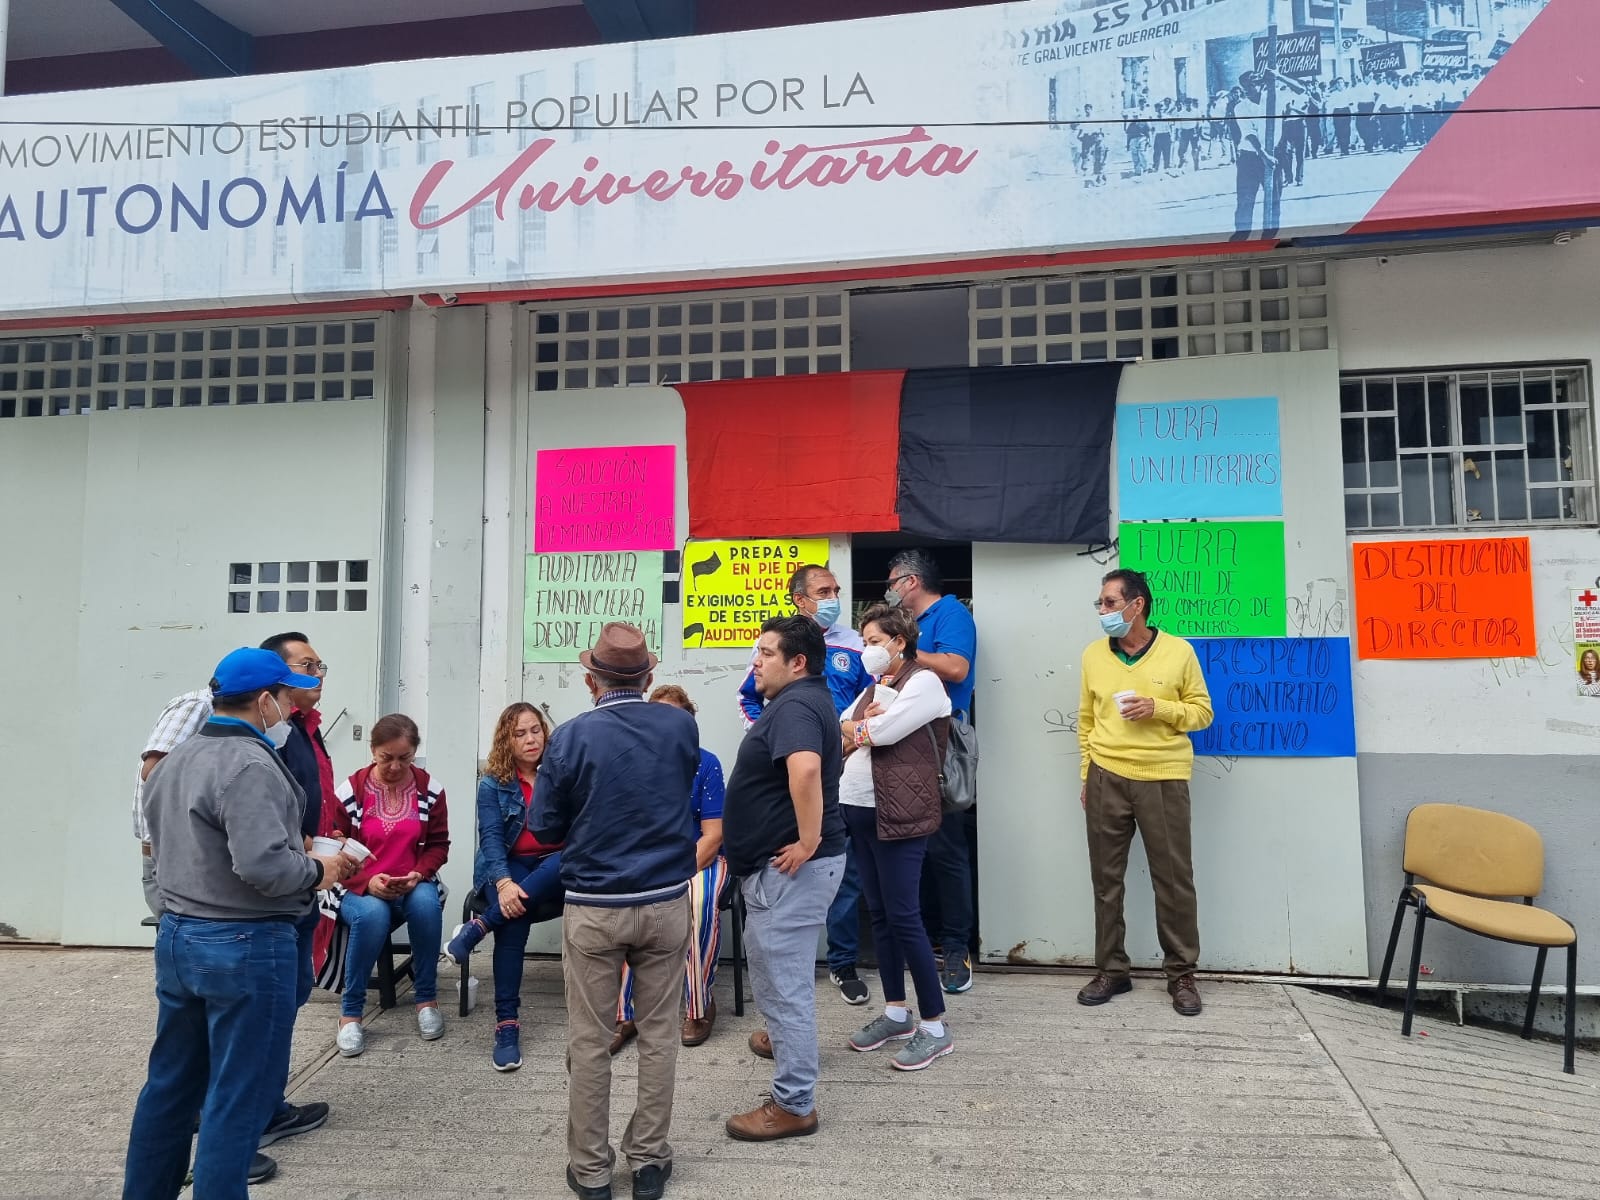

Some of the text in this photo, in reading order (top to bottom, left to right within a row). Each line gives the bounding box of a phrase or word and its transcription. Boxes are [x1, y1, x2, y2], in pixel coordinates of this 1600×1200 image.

[1092, 2, 1131, 33] ES
[1255, 35, 1316, 58] AUONOMIA
[0, 71, 876, 169] MOVIMIENTO ESTUDIANTIL POPULAR POR LA
[0, 126, 980, 242] AUTONOMÍA Universitaria
[1138, 404, 1219, 441] FUERA
[1130, 453, 1278, 486] UNILATERALES
[540, 494, 552, 518] A
[730, 545, 799, 560] PREPA 9
[1137, 528, 1238, 567] FUERA
[1359, 538, 1528, 580] DESTITUCIÓN
[538, 551, 637, 583] AUDITORIA
[733, 563, 750, 575] EN
[759, 562, 781, 574] PIE
[1215, 570, 1238, 596] DE
[1413, 581, 1469, 614] DEL
[536, 588, 645, 618] FINANCIERA
[687, 594, 755, 607] EXIGIMOS
[760, 593, 779, 606] LA
[1175, 598, 1241, 618] COMPLETO
[1250, 597, 1273, 618] DE
[709, 610, 727, 623] DE
[1177, 619, 1239, 635] CENTROS
[532, 620, 581, 649] DESDE
[704, 628, 762, 641] AUDITOR
[1200, 638, 1330, 679] RESPETO
[1227, 681, 1338, 715] CONTRATO
